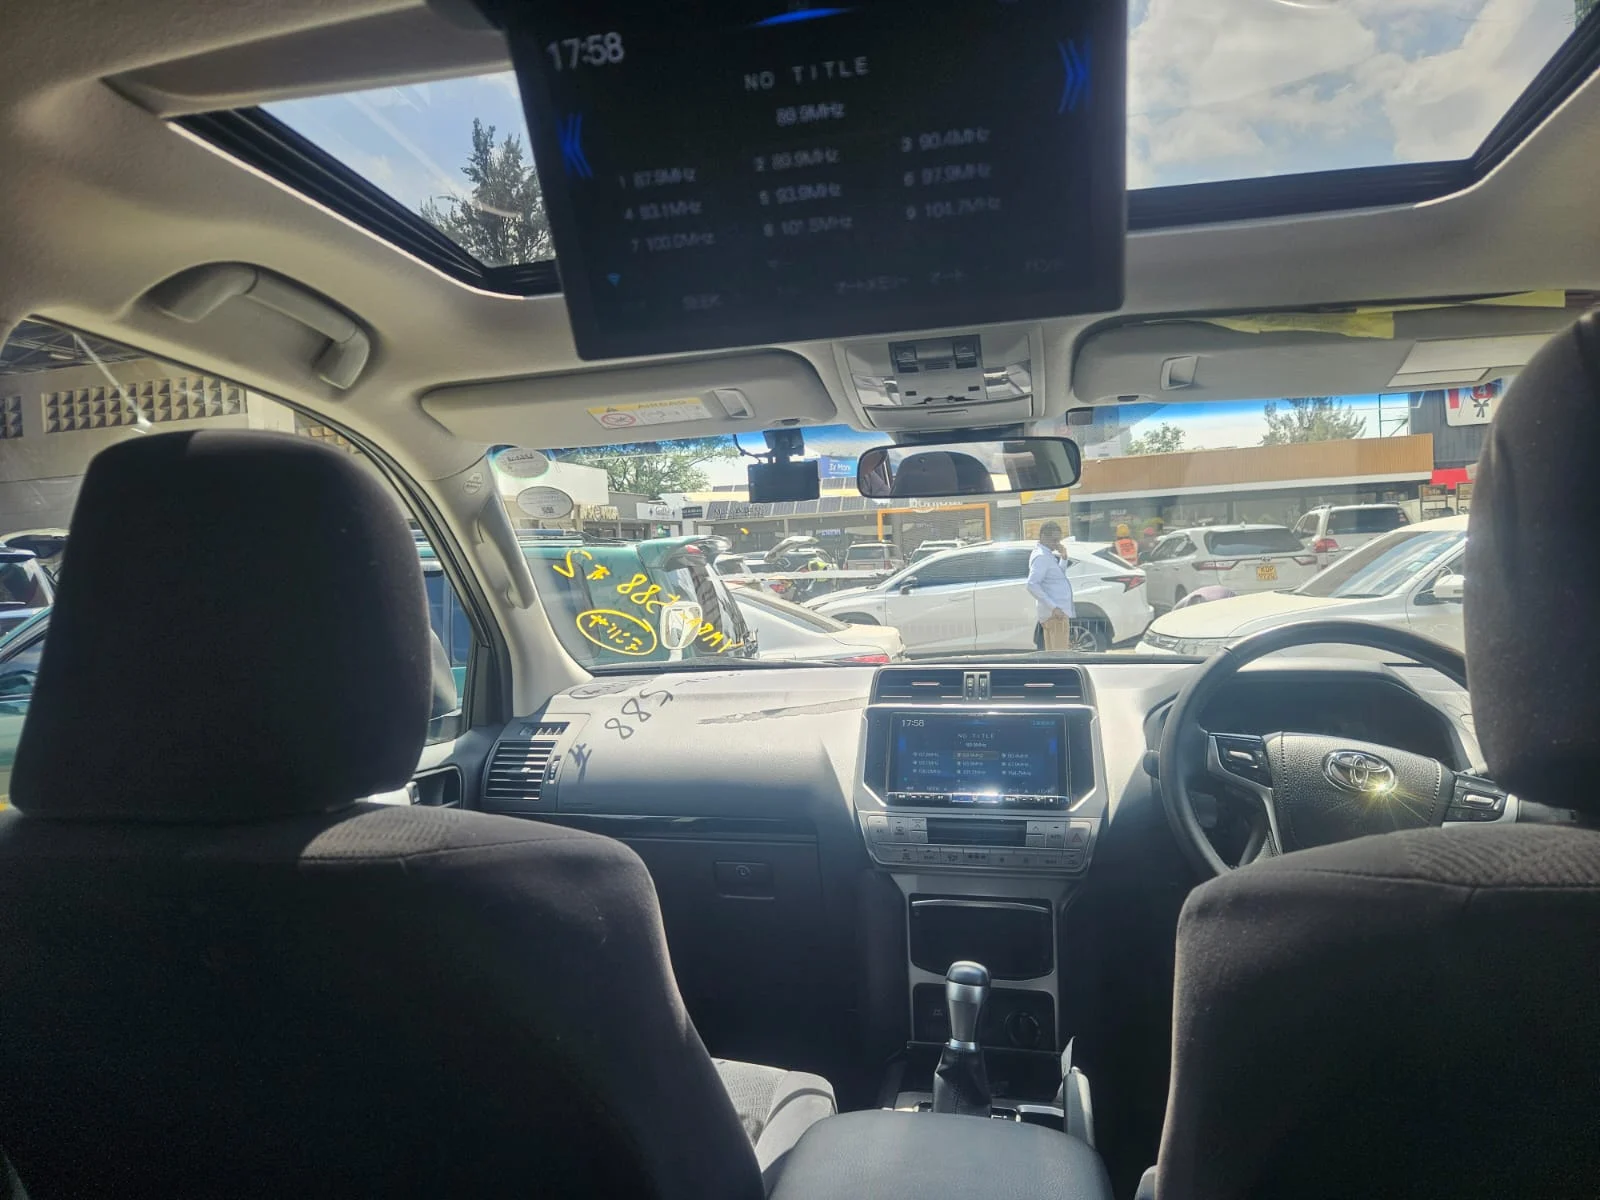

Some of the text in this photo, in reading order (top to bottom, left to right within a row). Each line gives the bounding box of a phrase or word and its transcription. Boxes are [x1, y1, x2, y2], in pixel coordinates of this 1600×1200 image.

[546, 31, 625, 71] 17:58
[743, 55, 870, 92] NO TITLE
[901, 719, 925, 728] 17:58
